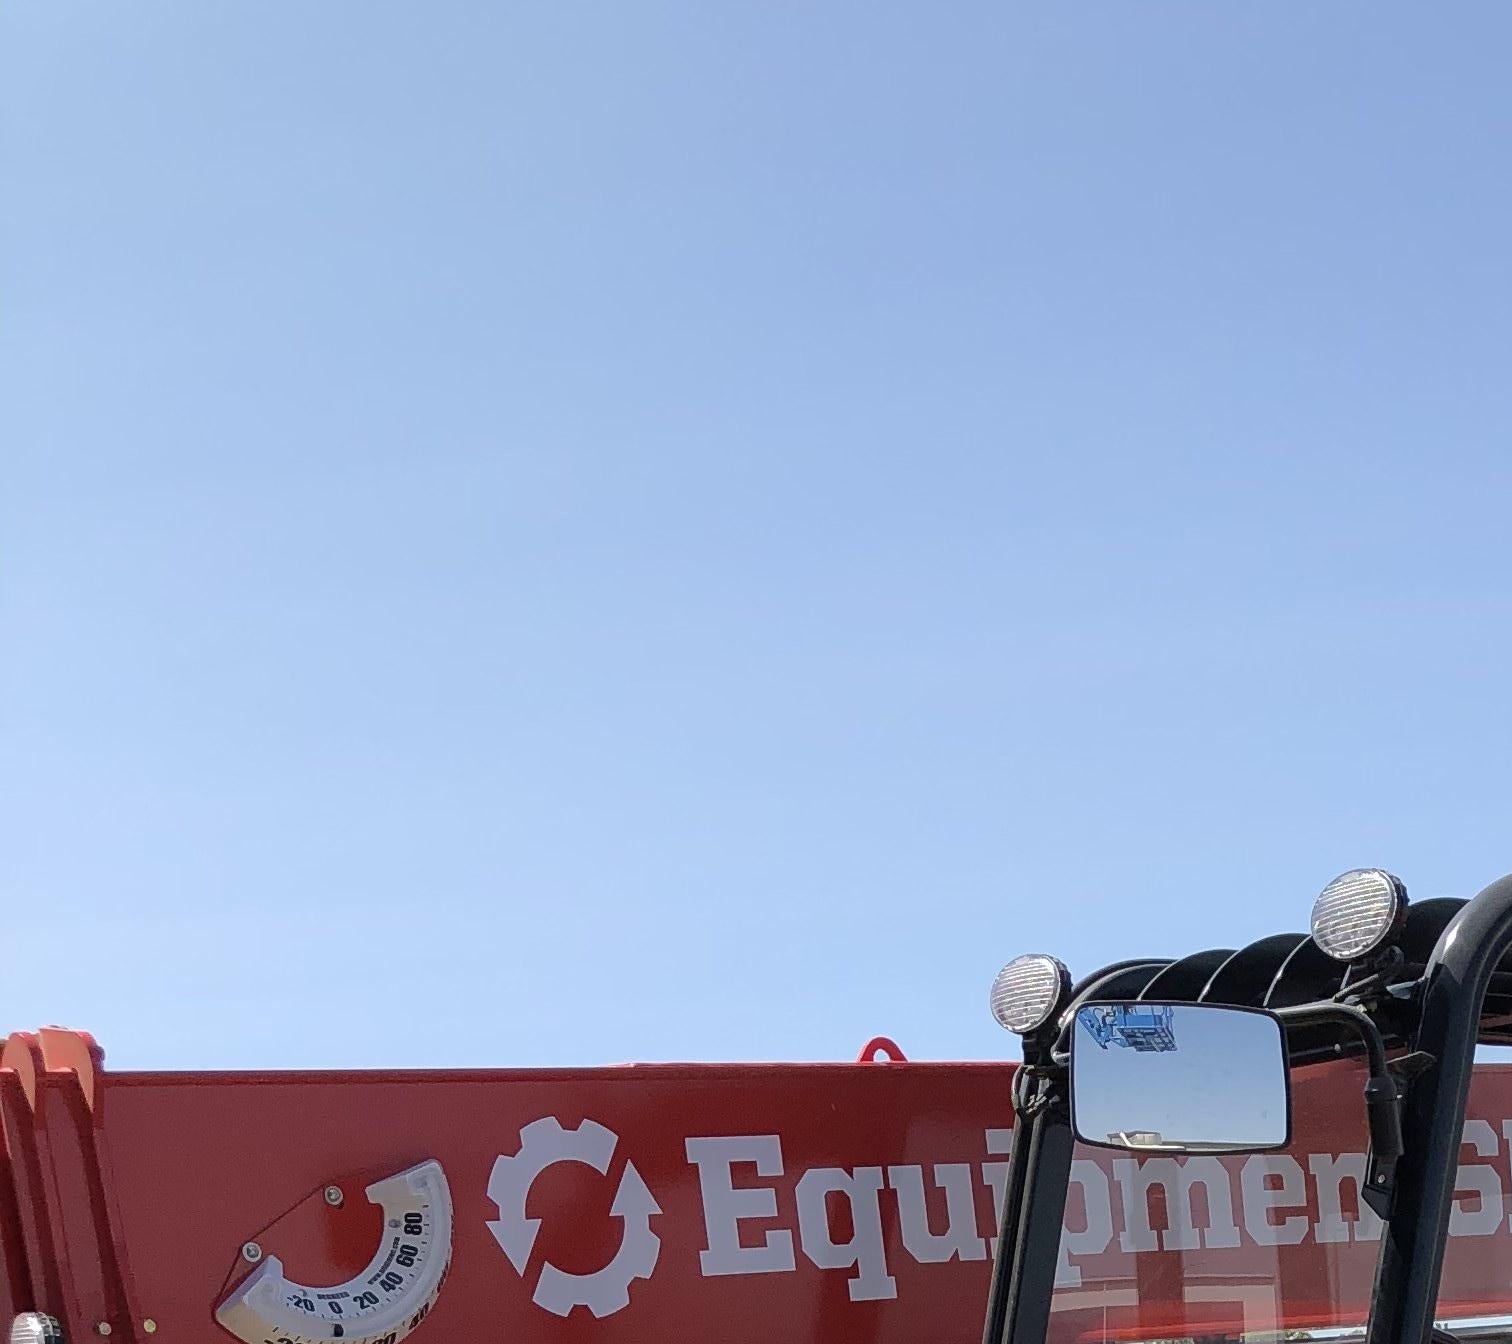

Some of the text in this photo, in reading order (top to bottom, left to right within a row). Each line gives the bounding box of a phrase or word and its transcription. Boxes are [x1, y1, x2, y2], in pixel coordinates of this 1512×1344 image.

[404, 1212, 423, 1236] 80
[396, 1244, 419, 1268] 60
[378, 1271, 404, 1293] 40
[328, 1301, 343, 1315] 0
[352, 1291, 380, 1310] 20
